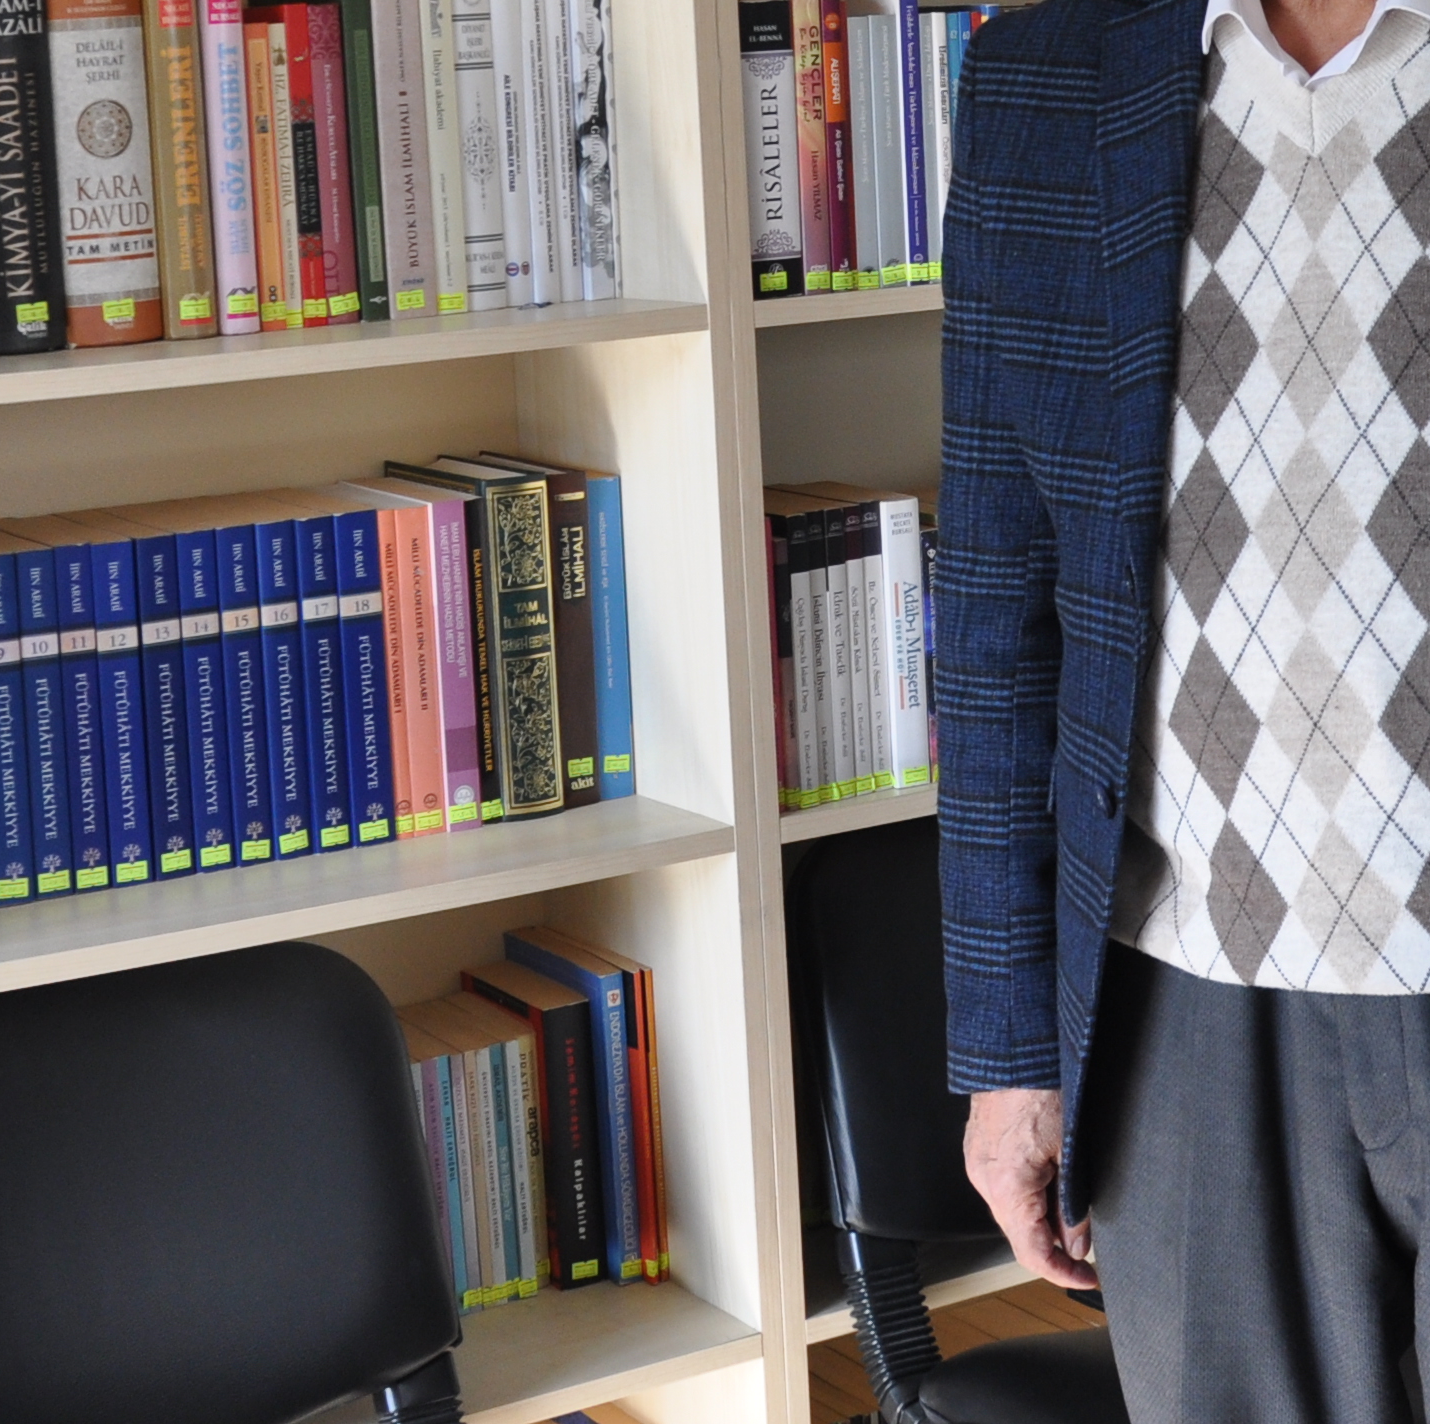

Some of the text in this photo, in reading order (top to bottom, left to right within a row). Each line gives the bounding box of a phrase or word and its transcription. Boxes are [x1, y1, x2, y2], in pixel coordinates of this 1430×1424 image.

[76, 54, 125, 68] HAYRAT
[218, 43, 246, 211] SÖZ SOHBET
[759, 84, 783, 222] RİSÂLELER
[75, 174, 142, 201] KARA
[70, 202, 149, 231] DAVUD
[66, 239, 154, 256] TAM METİN
[354, 599, 369, 612] 18
[514, 601, 539, 614] TAM
[273, 609, 289, 623] 16
[31, 639, 48, 654] 10
[110, 633, 126, 646] 12
[906, 636, 921, 709] Muaşeret
[571, 777, 595, 791] akit
